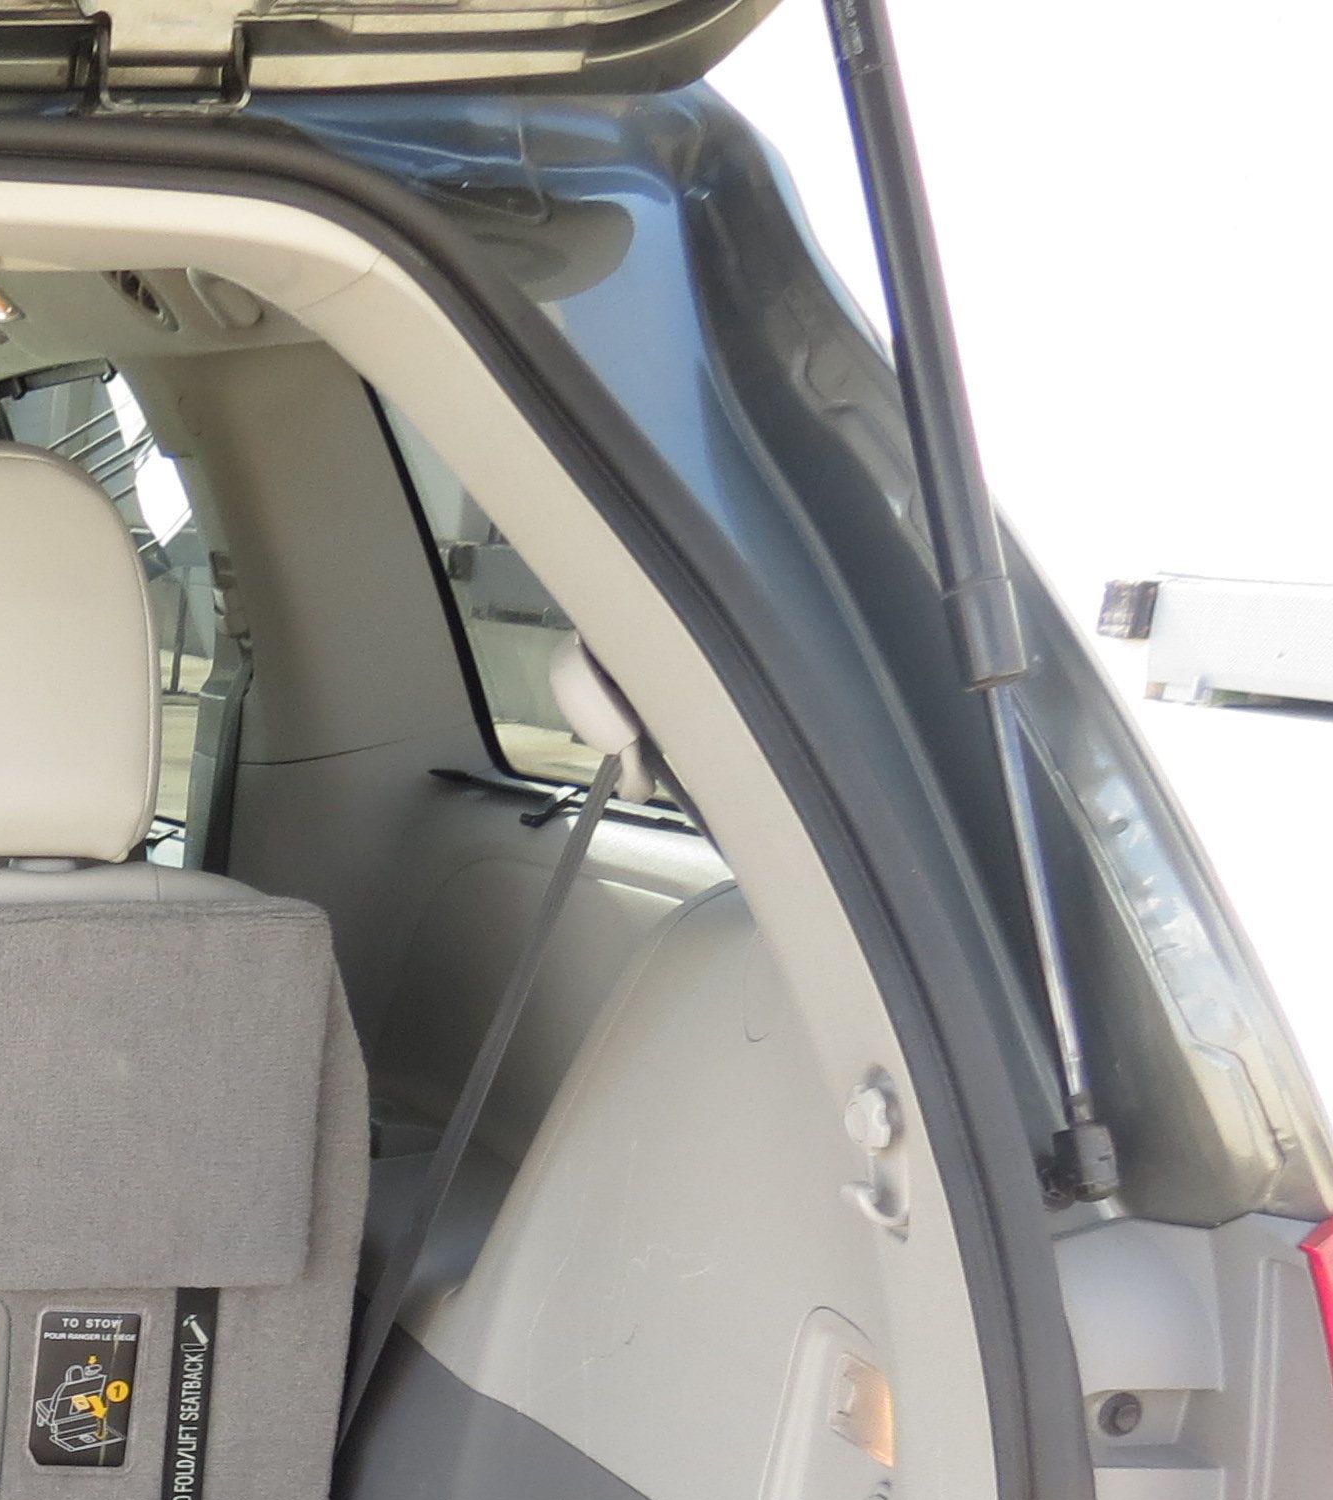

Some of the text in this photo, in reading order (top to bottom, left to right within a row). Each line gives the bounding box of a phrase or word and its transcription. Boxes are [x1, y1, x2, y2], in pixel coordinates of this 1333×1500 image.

[61, 1318, 123, 1328] TO STOW
[180, 1356, 205, 1421] SEATBACK
[174, 1424, 198, 1492] FOLD/LIFT
